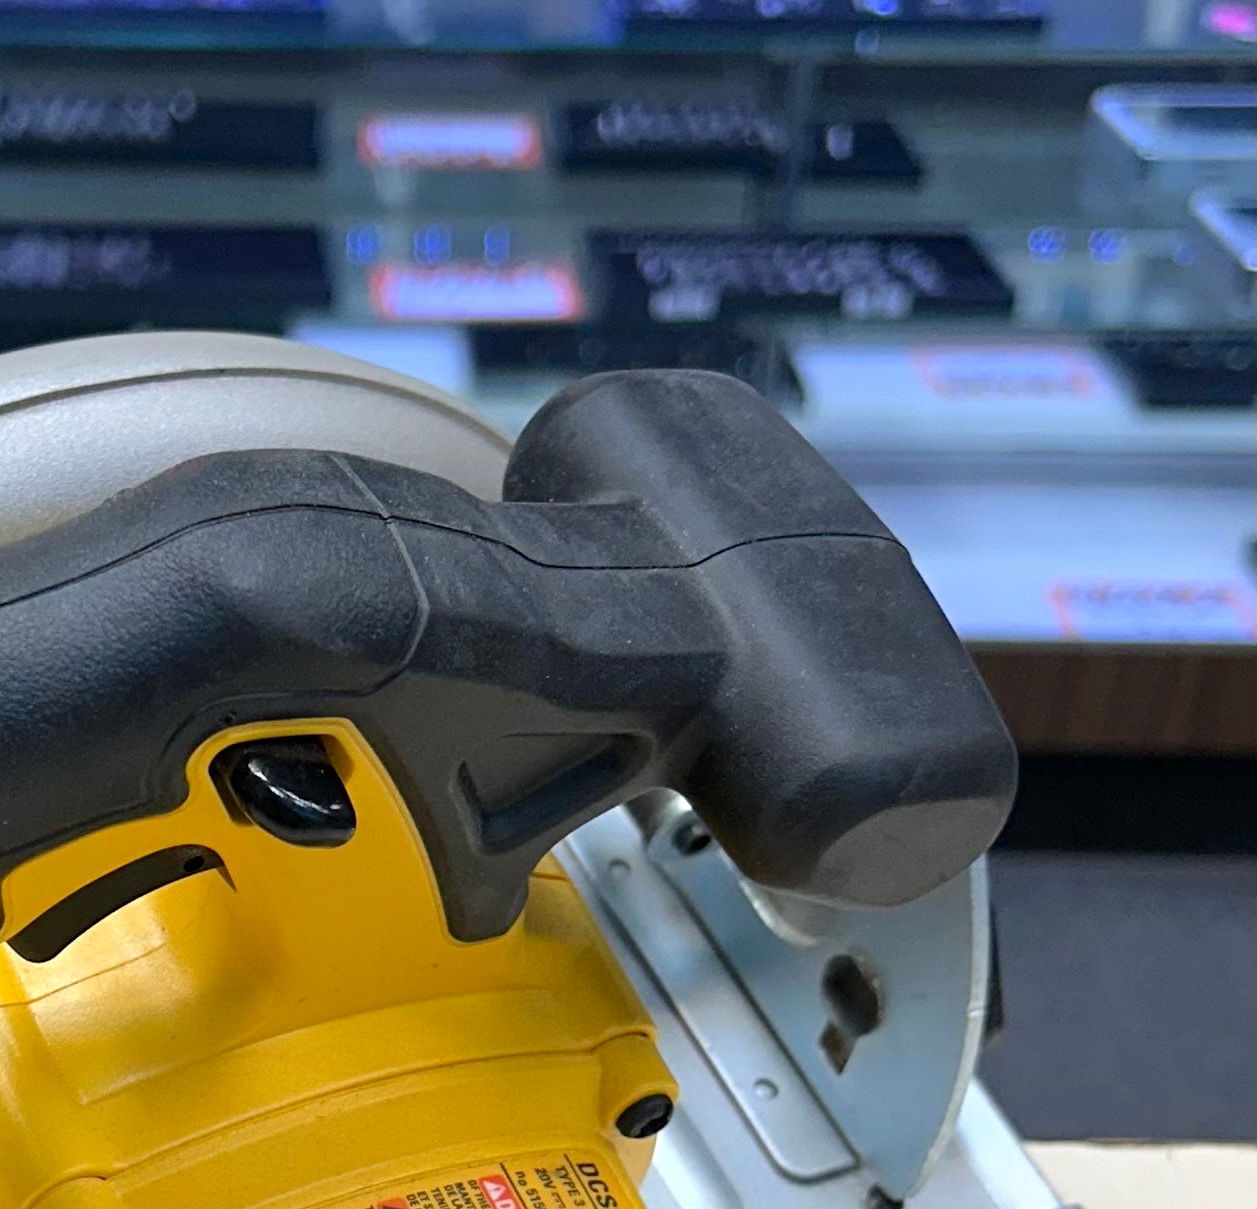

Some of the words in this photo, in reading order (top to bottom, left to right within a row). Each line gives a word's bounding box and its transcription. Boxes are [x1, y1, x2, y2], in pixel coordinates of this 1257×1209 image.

[533, 1165, 556, 1191] 20V
[553, 1165, 581, 1198] TYPE
[571, 1196, 586, 1207] 3
